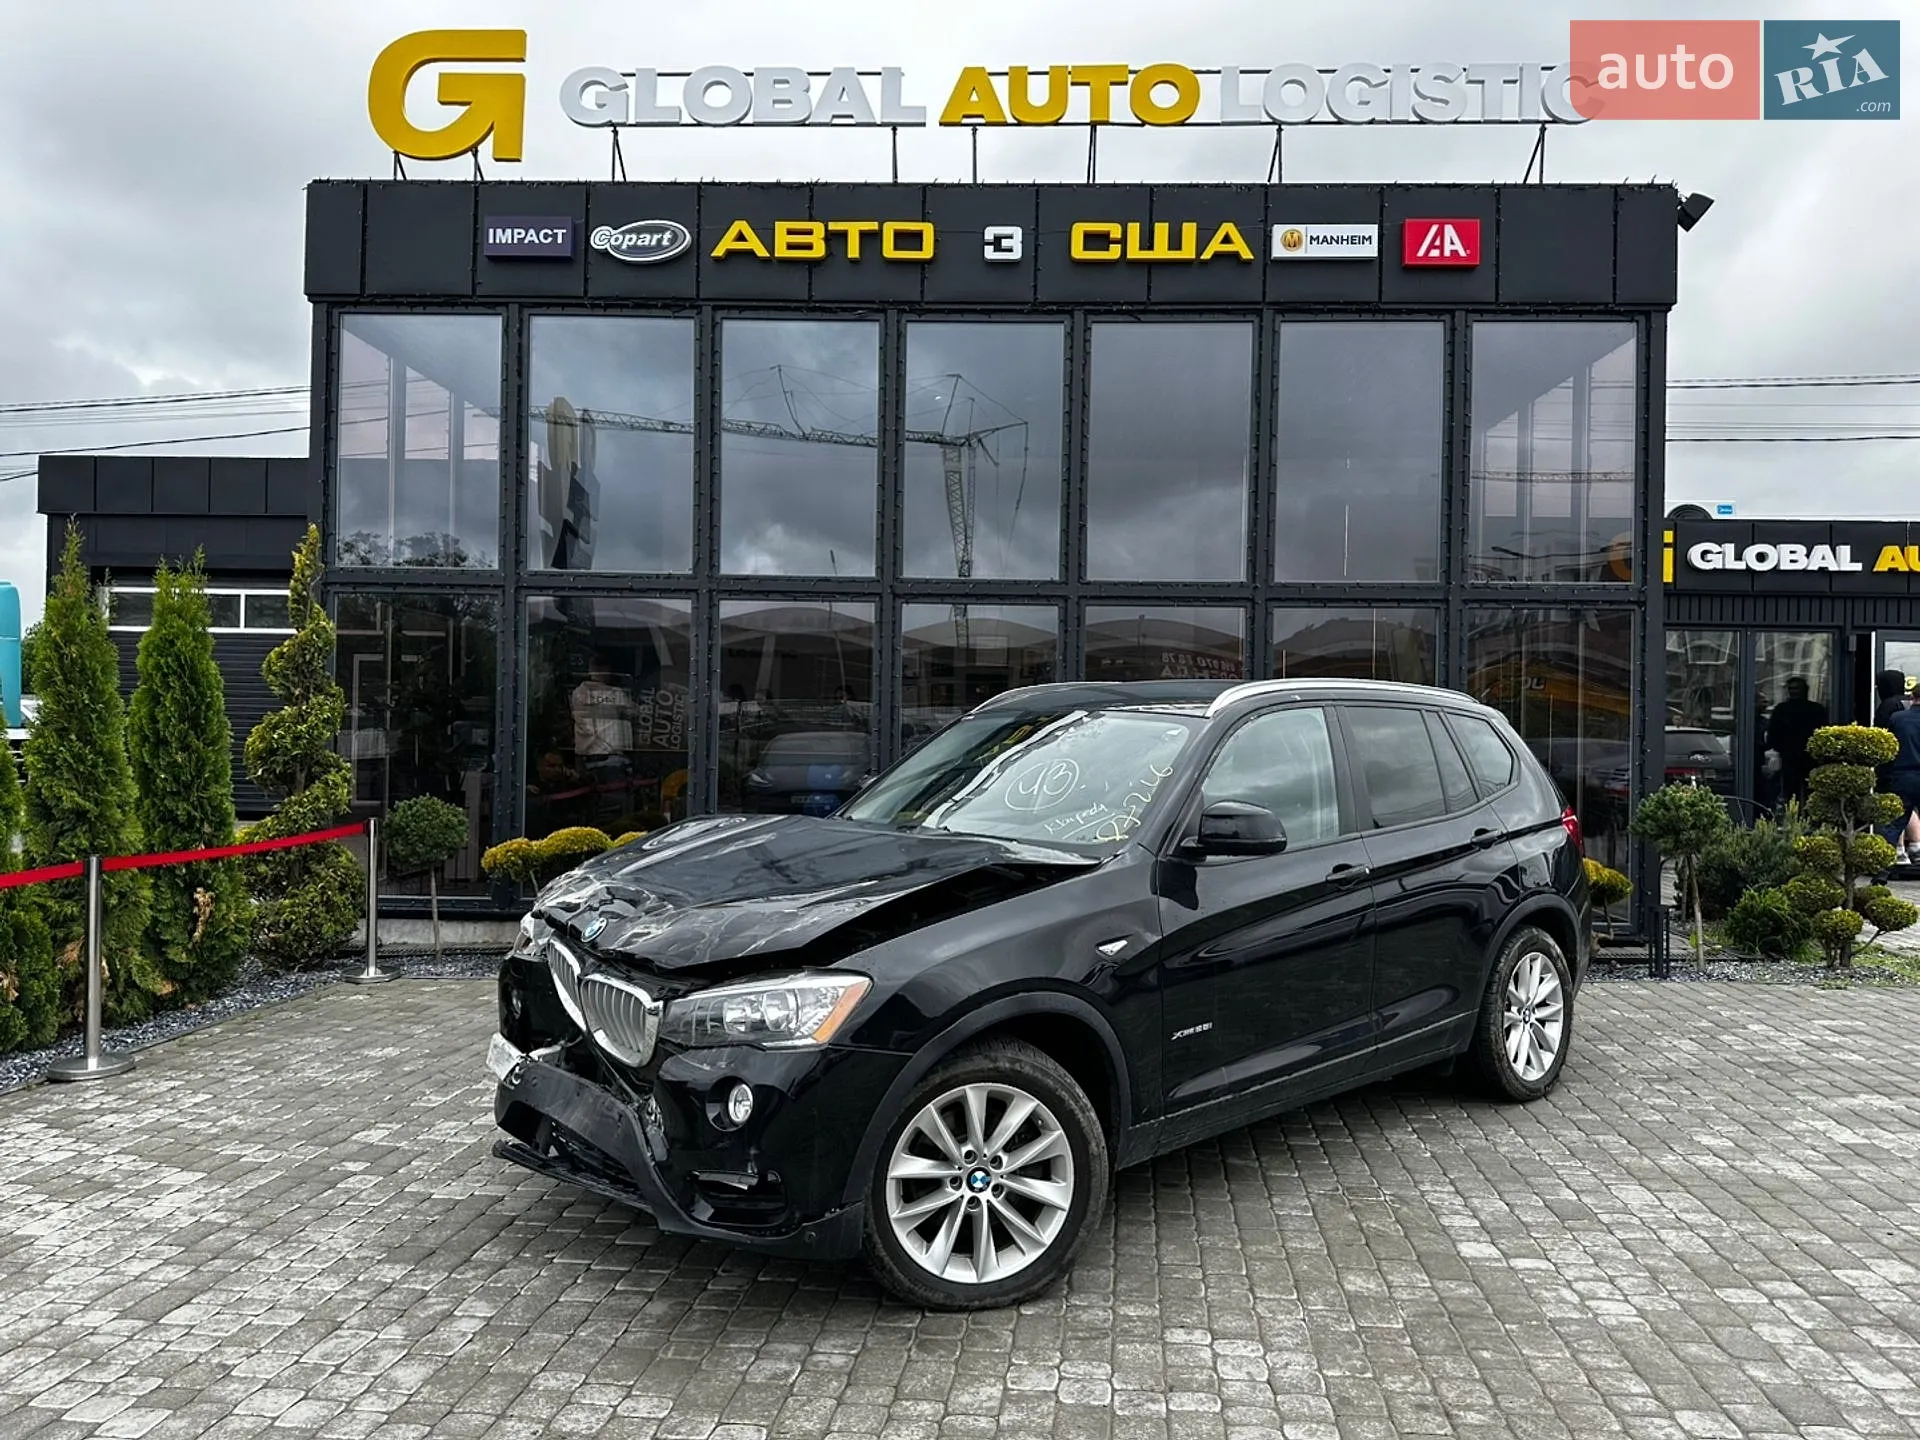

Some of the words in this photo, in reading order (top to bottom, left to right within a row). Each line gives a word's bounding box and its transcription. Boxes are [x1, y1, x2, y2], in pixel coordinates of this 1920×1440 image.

[559, 65, 926, 127] GLOBAL
[939, 63, 1200, 127] AUTO
[1220, 61, 1606, 125] LOGISTIC
[488, 228, 567, 244] IMPACT
[594, 229, 674, 249] Copart
[710, 219, 935, 260] АВТО
[1070, 221, 1255, 262] США
[1309, 234, 1373, 245] MANHEIM
[1687, 542, 1863, 571] GLOBAL
[640, 687, 655, 744] GLOBAL
[652, 690, 673, 748] AUTO
[670, 694, 685, 750] LOGISTIC
